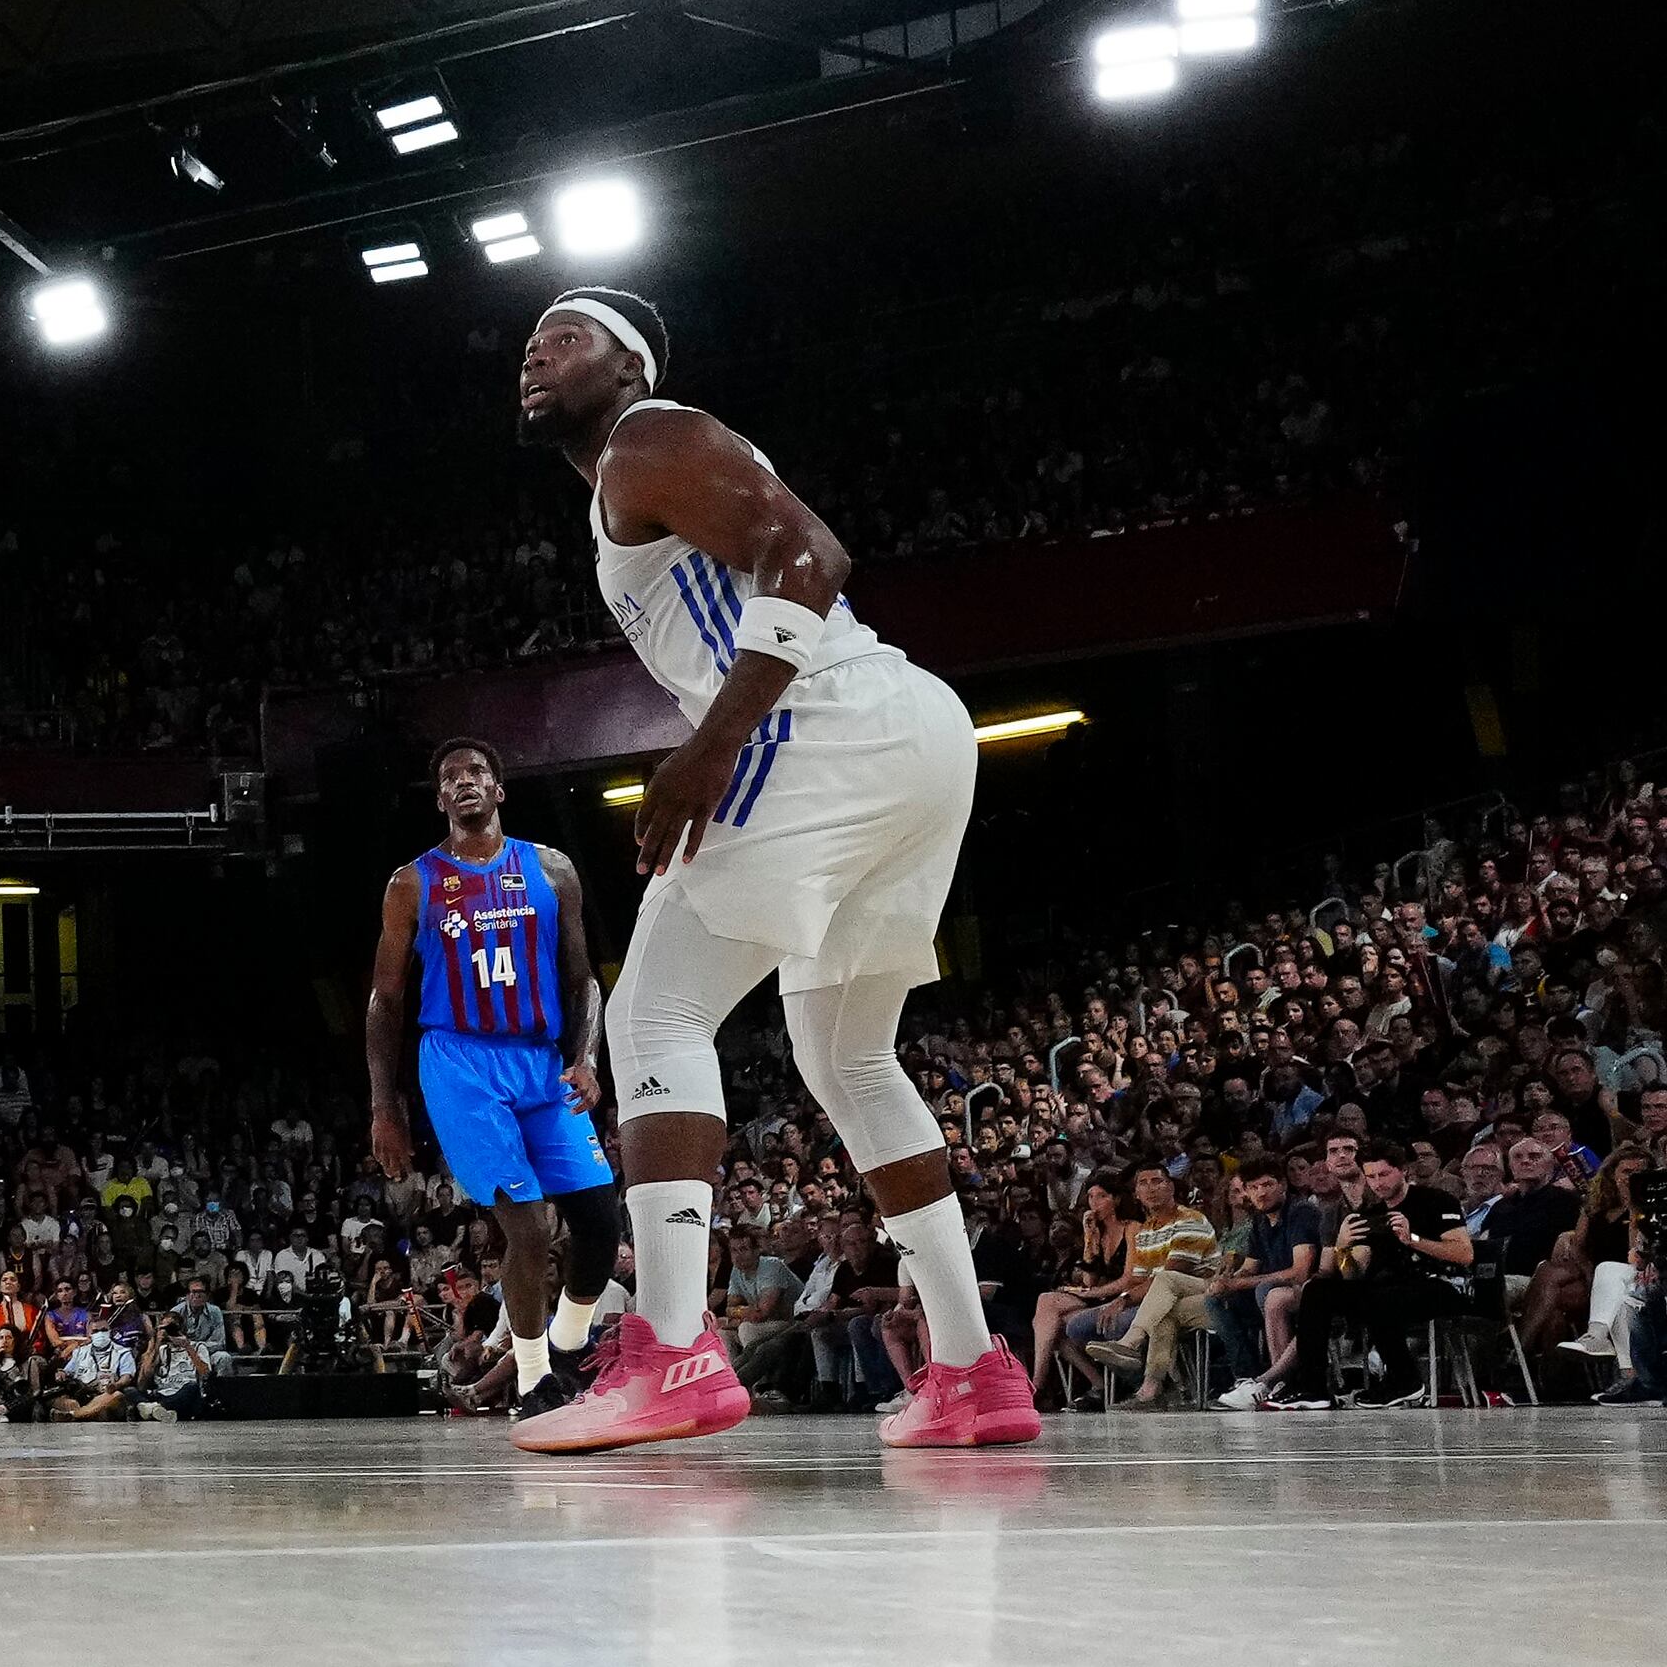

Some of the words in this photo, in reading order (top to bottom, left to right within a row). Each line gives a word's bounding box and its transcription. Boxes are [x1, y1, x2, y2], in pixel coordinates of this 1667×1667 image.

[473, 905, 535, 922] Assistència
[474, 918, 518, 933] Sanitària
[471, 946, 517, 989] 14
